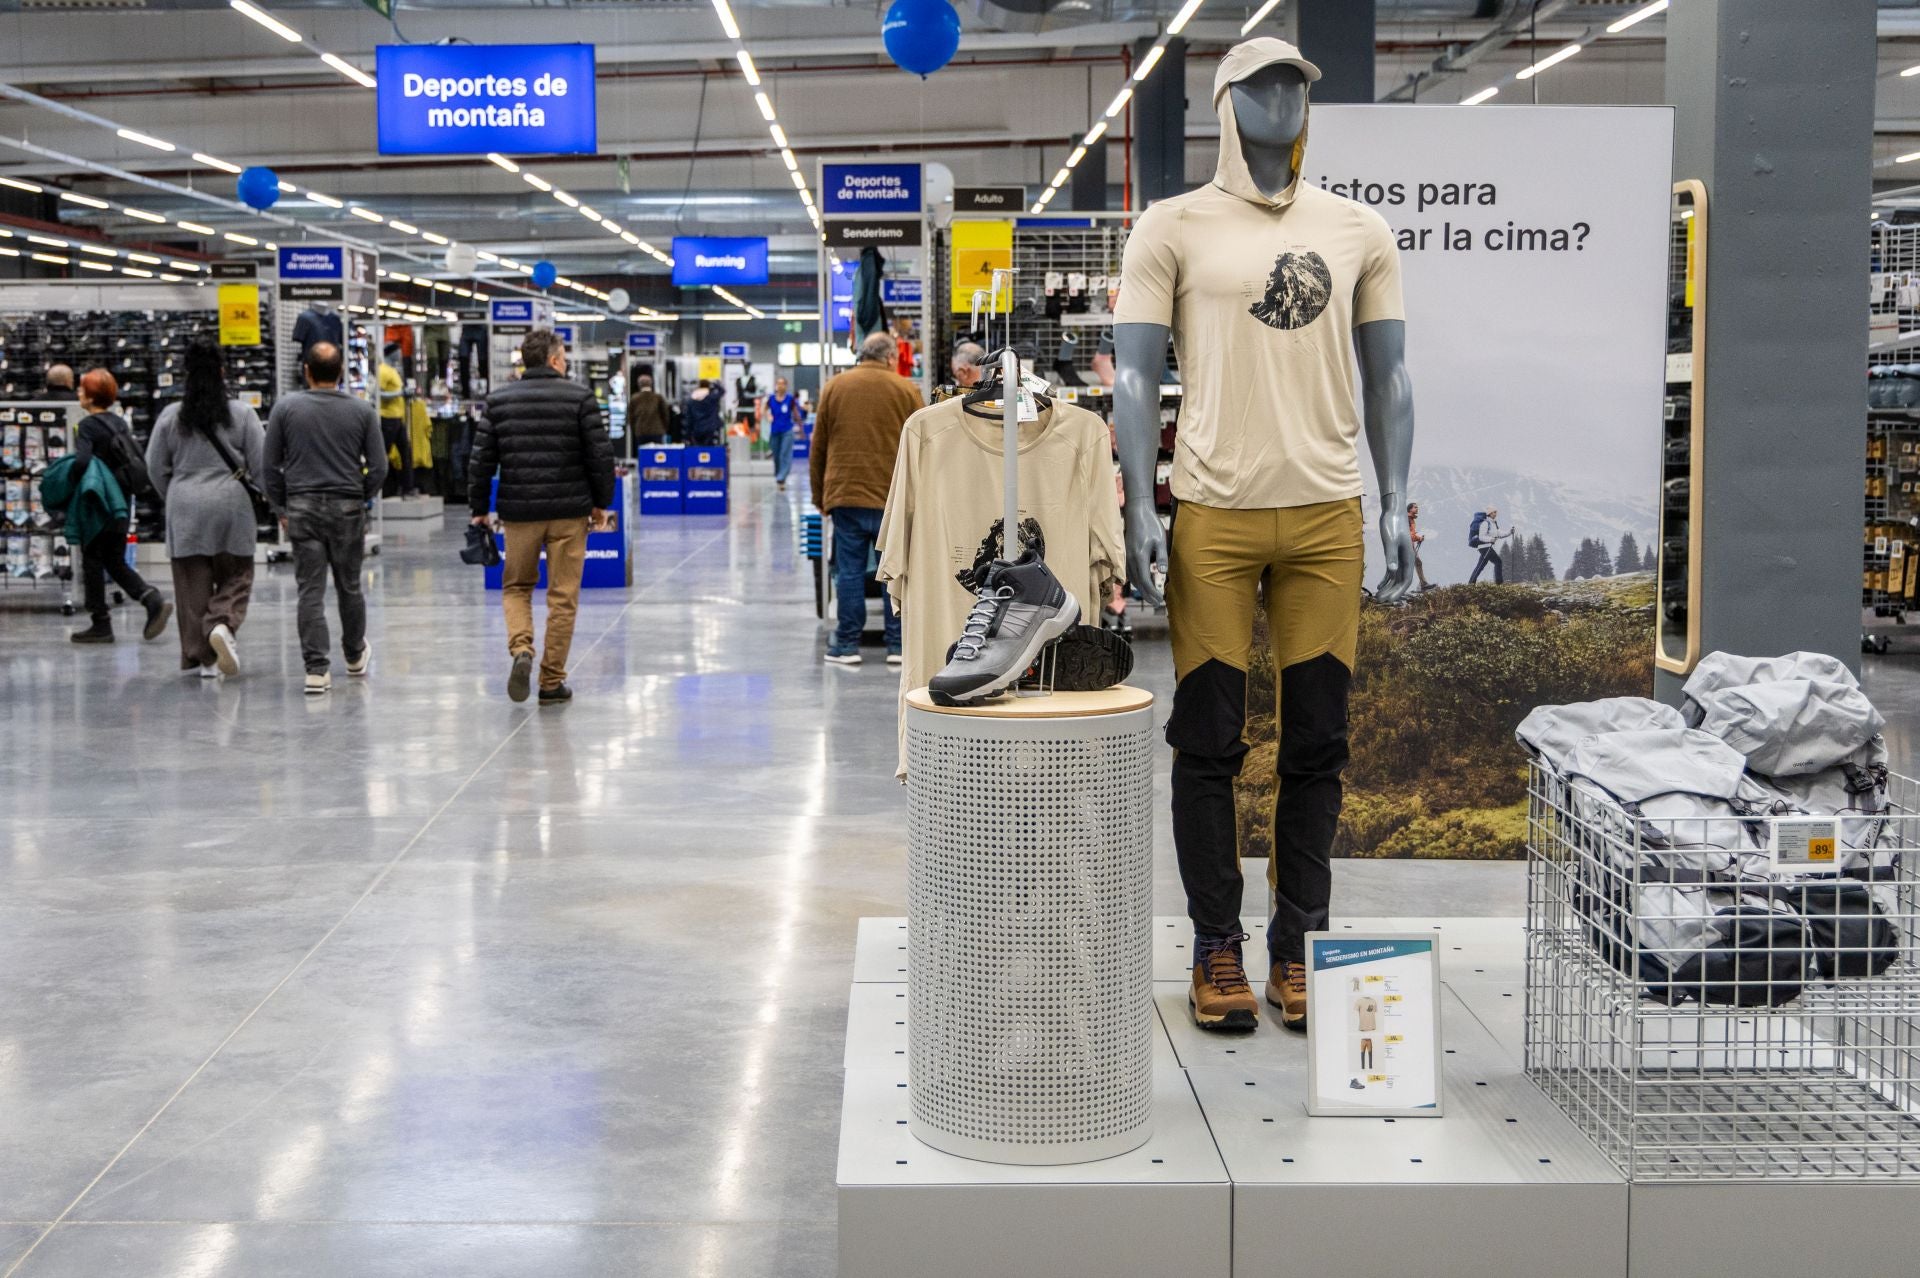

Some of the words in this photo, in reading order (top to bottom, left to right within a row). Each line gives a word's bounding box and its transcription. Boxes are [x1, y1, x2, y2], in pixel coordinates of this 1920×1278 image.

[403, 72, 527, 102] Deportes
[533, 72, 568, 97] de
[427, 102, 545, 127] montaña
[845, 175, 902, 188] Deportes
[837, 188, 853, 199] de
[855, 187, 909, 199] montaña
[973, 194, 1004, 204] Adulto
[1320, 175, 1405, 205] istos
[1417, 182, 1497, 212] para
[842, 227, 904, 238] Senderismo
[1444, 222, 1472, 251] la
[1484, 221, 1591, 251] cima?
[290, 253, 330, 263] Deportes
[694, 254, 746, 270] Running
[1325, 951, 1360, 963] SENDERISMO
[1360, 949, 1368, 957] EN
[1368, 945, 1395, 956] MONTAÑA
